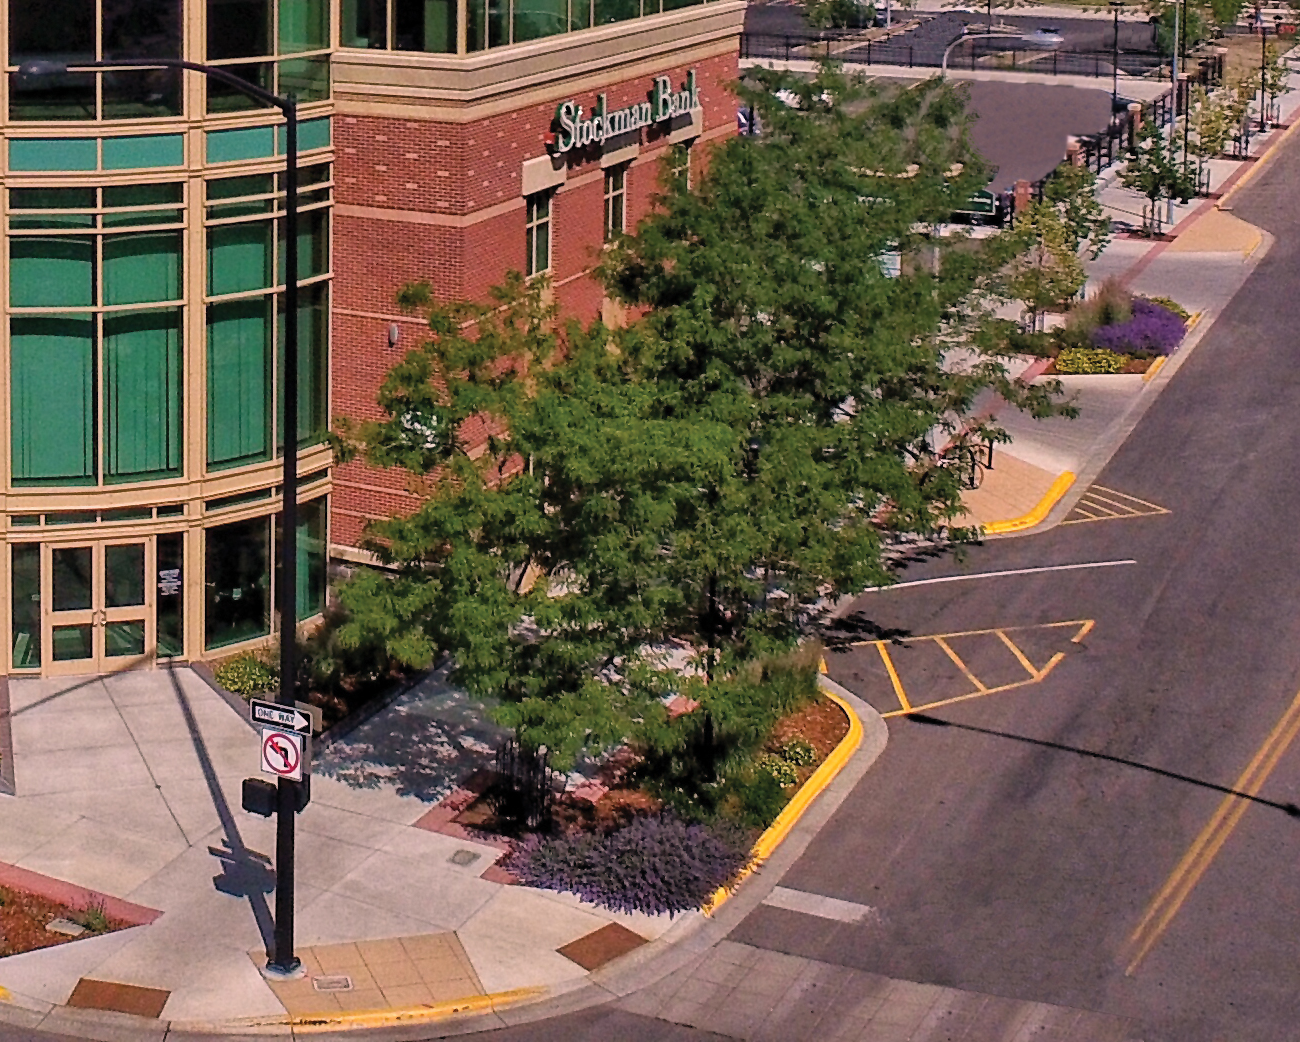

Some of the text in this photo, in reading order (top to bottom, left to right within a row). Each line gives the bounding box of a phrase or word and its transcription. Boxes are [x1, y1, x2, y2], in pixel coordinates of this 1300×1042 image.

[558, 69, 700, 153] Stockman Bank
[257, 708, 295, 724] ONE WAY
